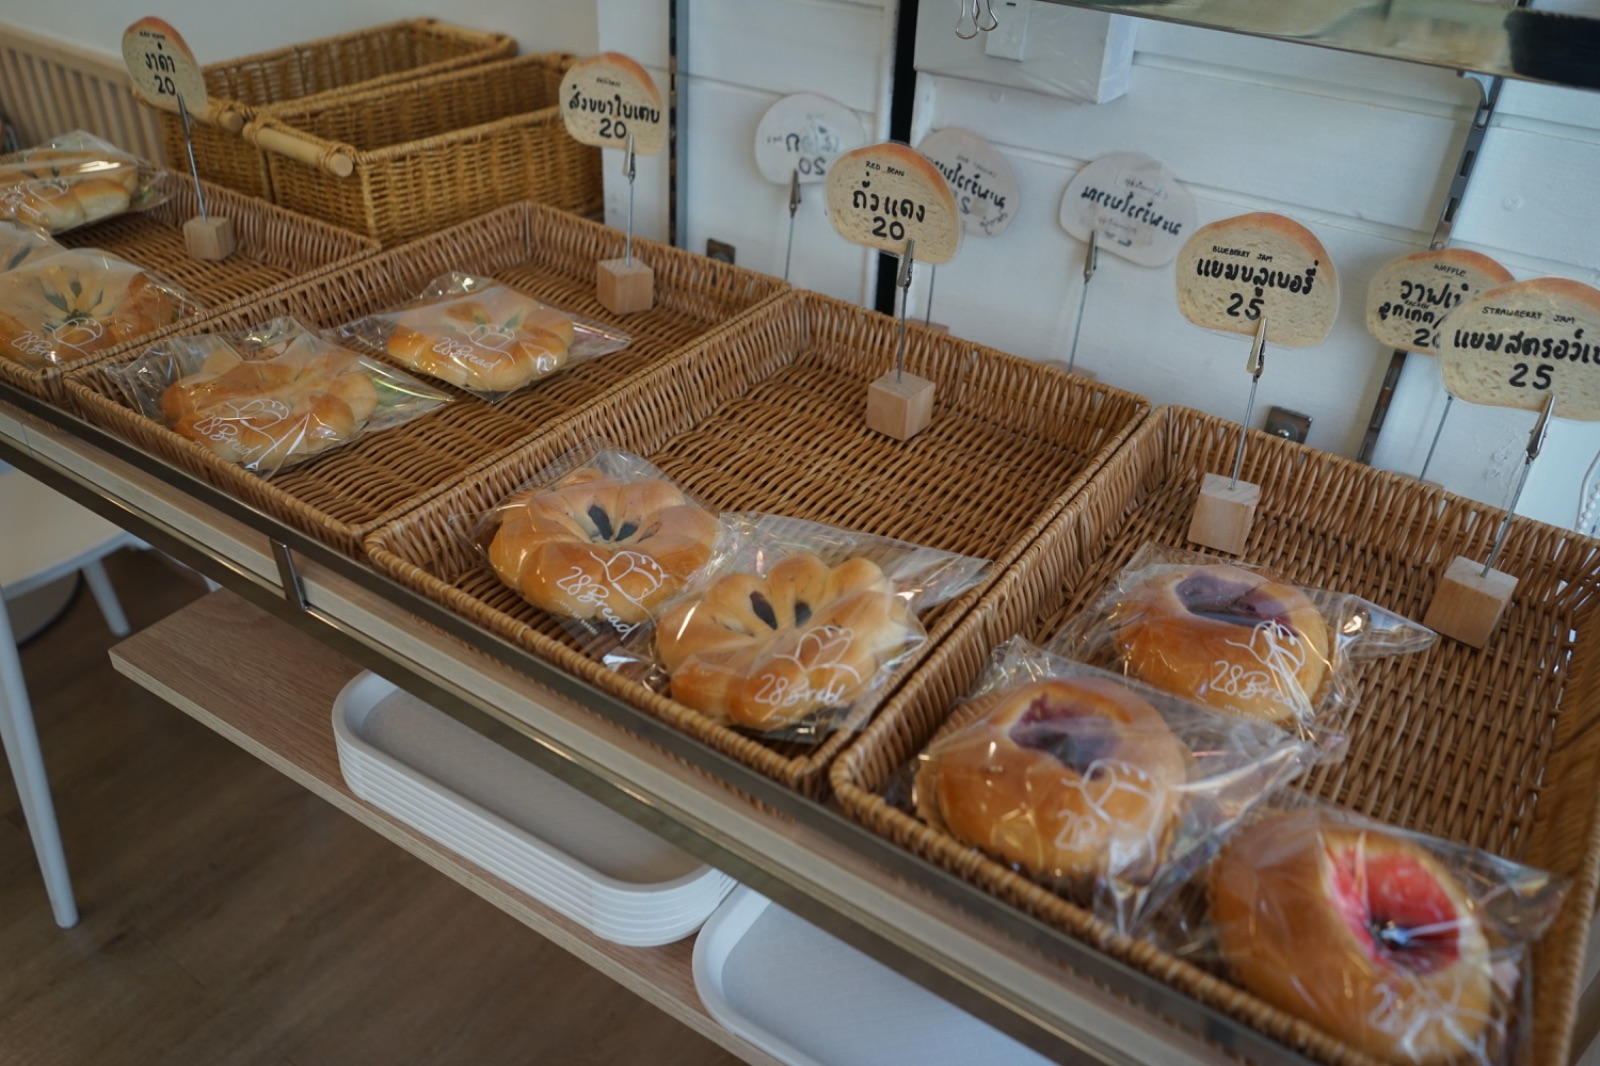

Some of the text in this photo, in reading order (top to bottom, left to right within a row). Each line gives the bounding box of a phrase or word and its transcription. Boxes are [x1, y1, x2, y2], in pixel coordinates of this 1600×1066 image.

[145, 42, 175, 74] งาดำ
[154, 74, 176, 96] 20
[599, 118, 627, 139] 20
[865, 161, 905, 177] RED BEAN
[853, 171, 926, 223] ถั่วแดง
[872, 216, 905, 241] 20
[1212, 245, 1274, 262] BLUEBERRY JAM
[1196, 258, 1319, 297] แยมบลูเบอรี่
[1434, 263, 1467, 277] WAFFLE
[1226, 293, 1265, 320] 25
[1482, 306, 1576, 325] STRAWBERRY JAM
[1508, 362, 1555, 390] 25
